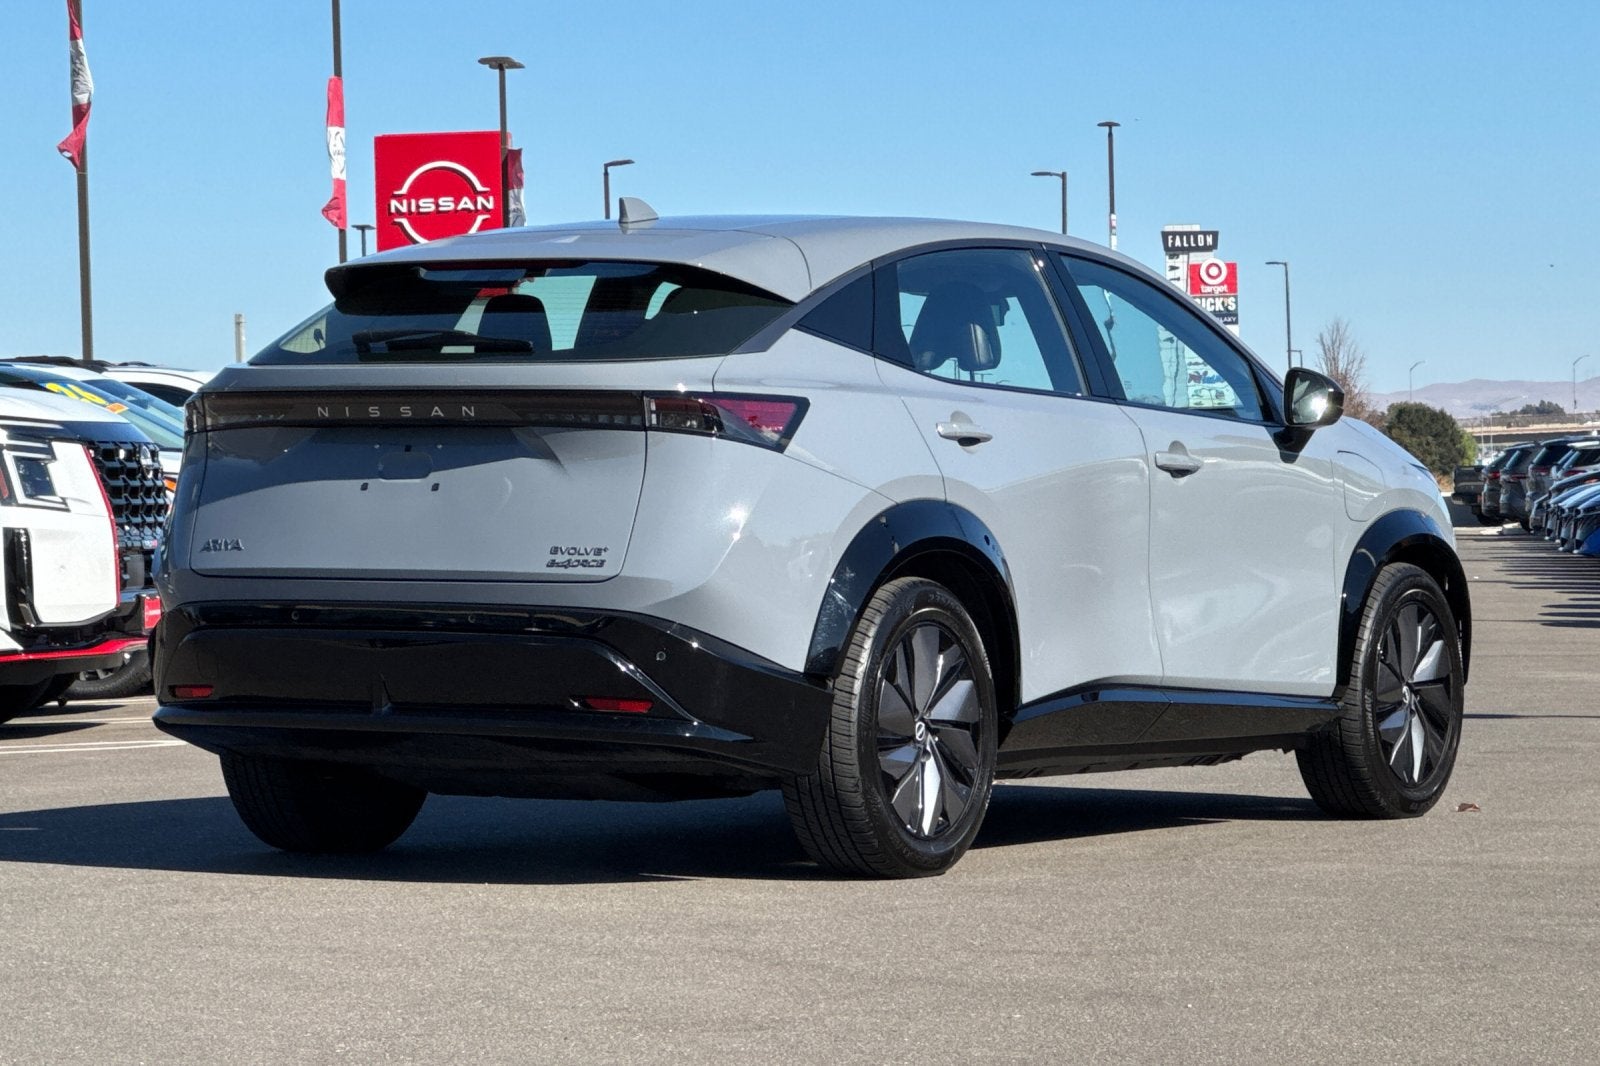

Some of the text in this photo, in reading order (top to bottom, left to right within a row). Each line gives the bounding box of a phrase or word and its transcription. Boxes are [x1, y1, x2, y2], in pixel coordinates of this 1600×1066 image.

[390, 196, 495, 214] NISSAN
[1167, 234, 1213, 248] FALLON
[317, 406, 475, 418] NISSAN
[200, 538, 245, 552] ARIYA
